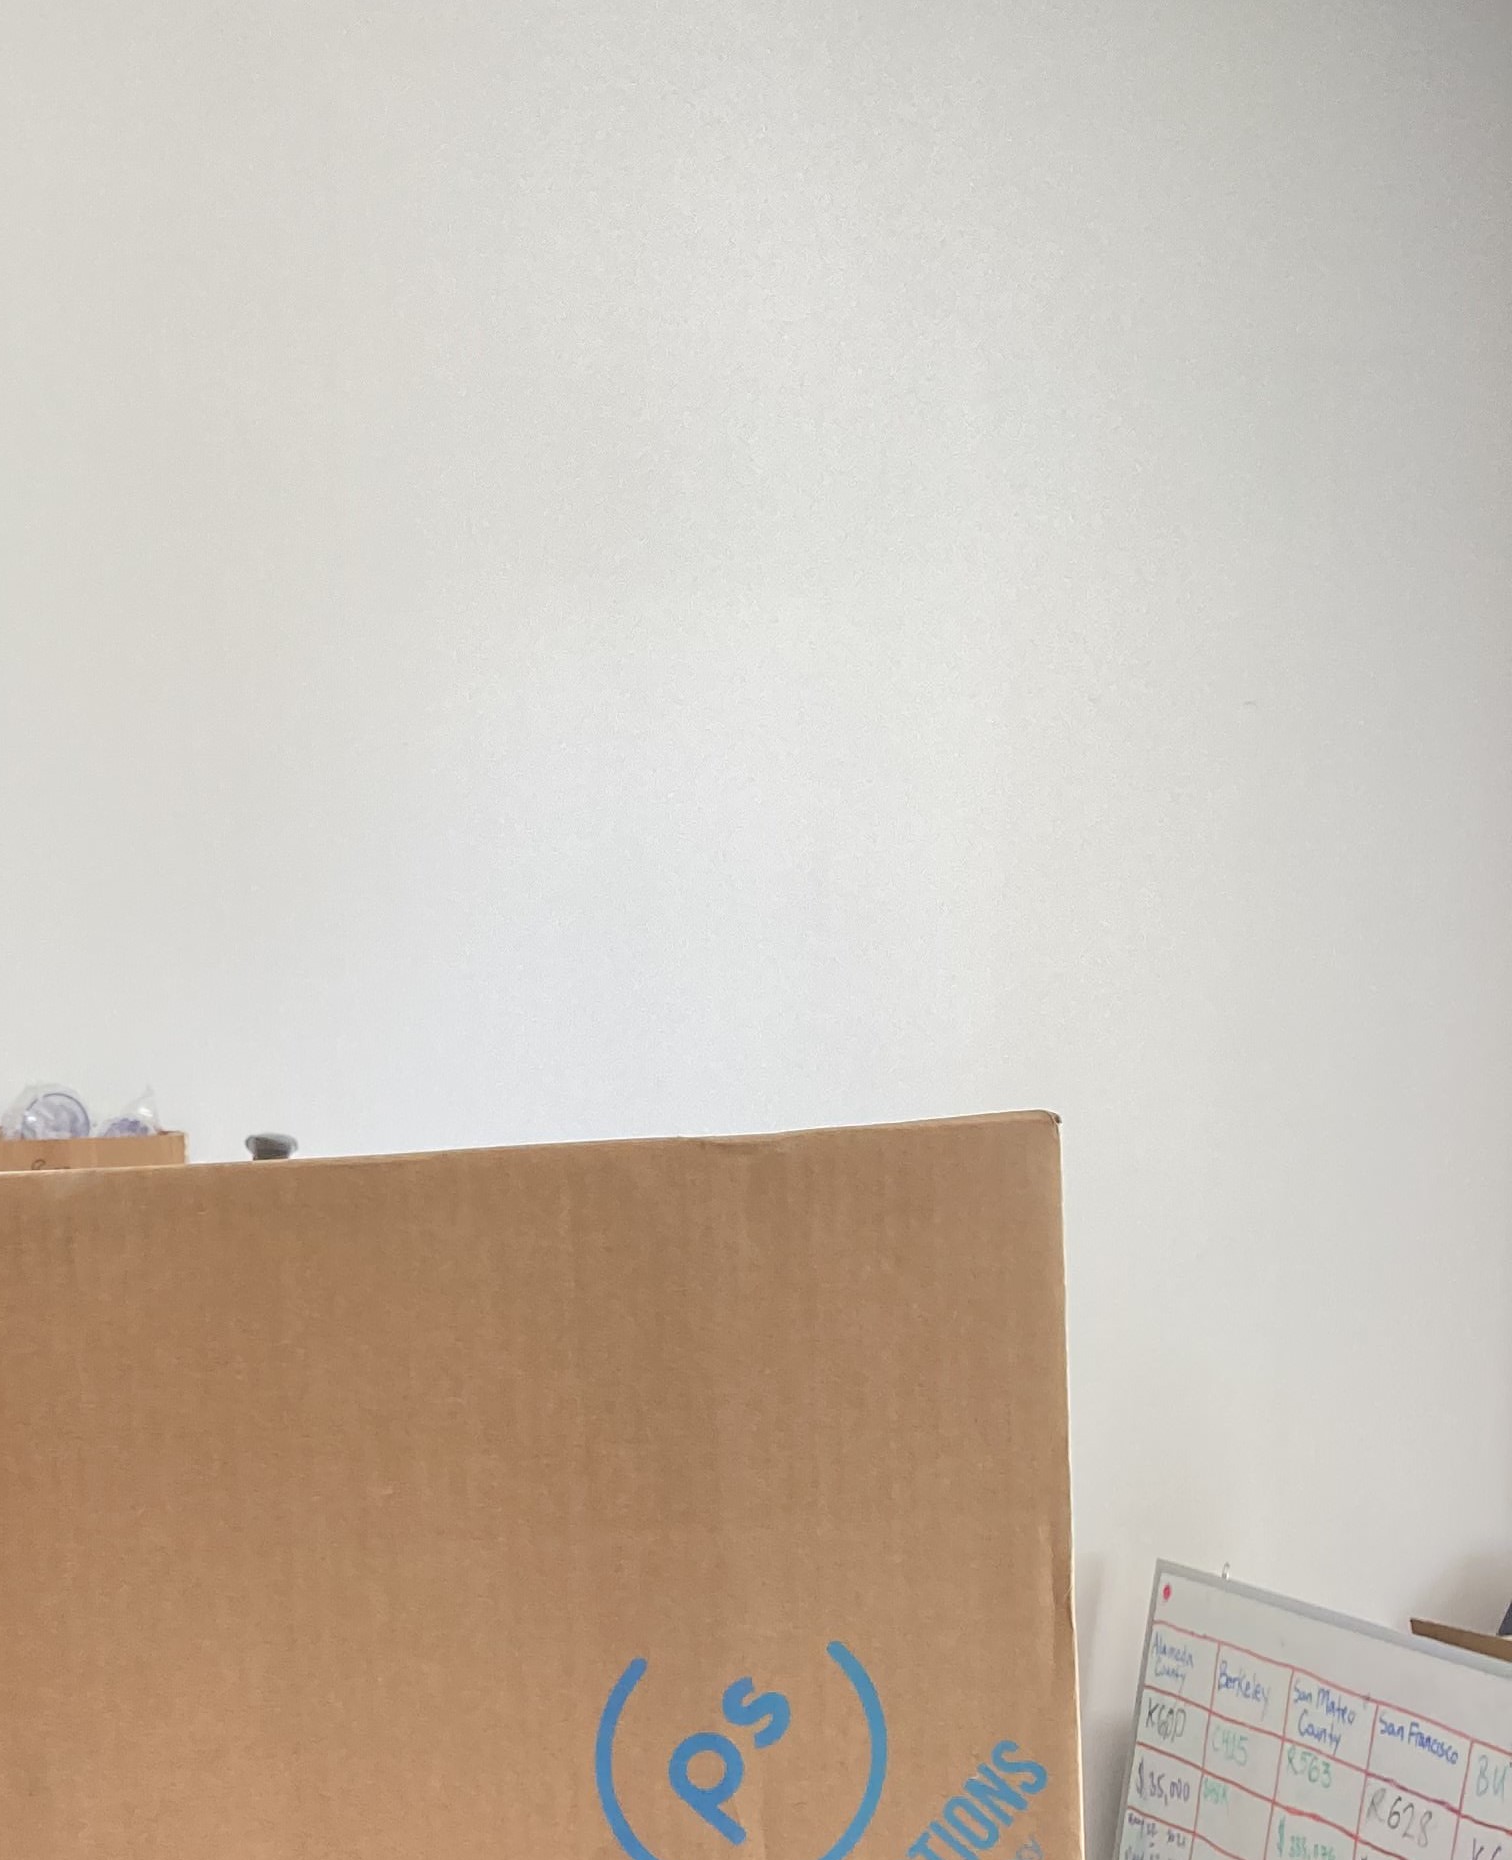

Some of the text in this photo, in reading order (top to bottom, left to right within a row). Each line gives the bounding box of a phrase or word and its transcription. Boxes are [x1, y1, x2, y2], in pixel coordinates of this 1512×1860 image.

[1293, 1679, 1313, 1704] San
[1297, 1709, 1342, 1757] County
[1378, 1711, 1406, 1742] San
